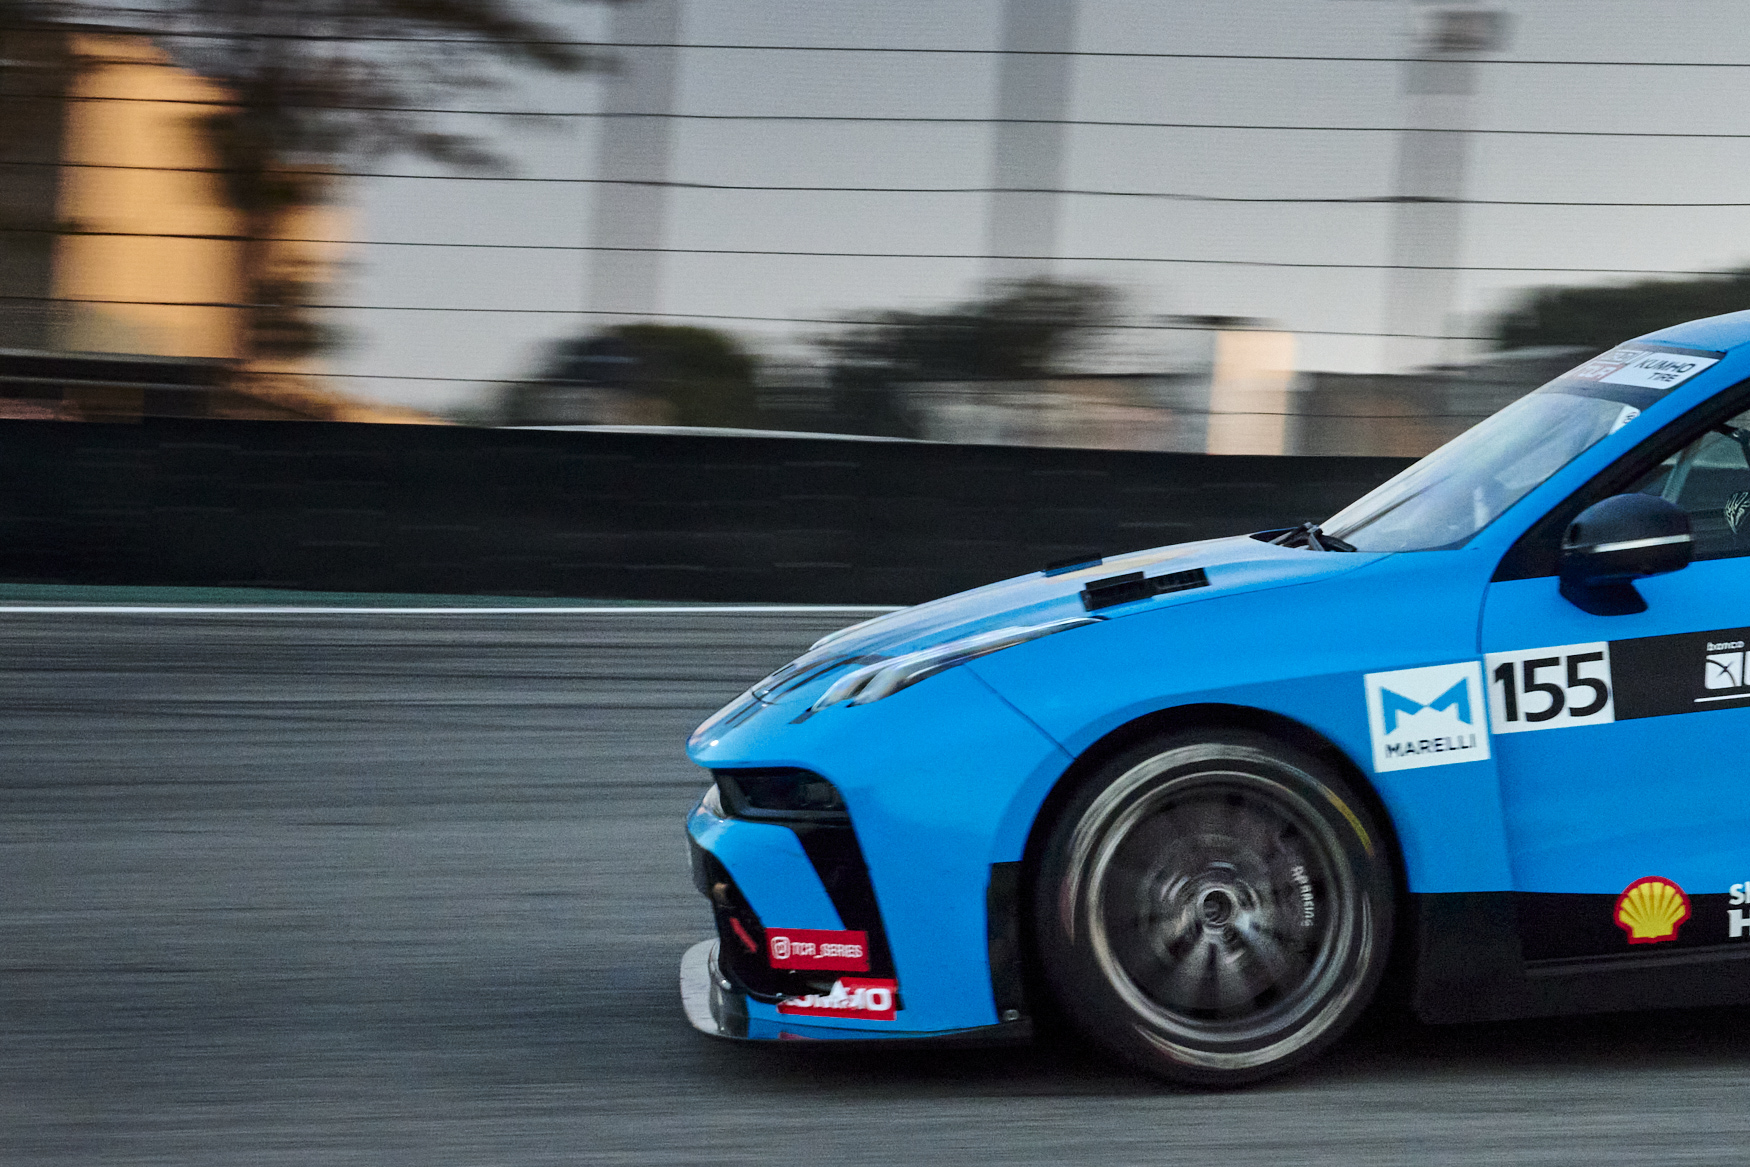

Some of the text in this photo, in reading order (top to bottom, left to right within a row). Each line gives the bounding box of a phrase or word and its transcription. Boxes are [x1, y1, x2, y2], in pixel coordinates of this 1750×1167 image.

[1634, 359, 1697, 373] KUMHO
[1648, 372, 1680, 382] TIRE
[1706, 640, 1745, 651] banco
[1494, 651, 1609, 723] 155
[1385, 733, 1478, 759] MARELLI
